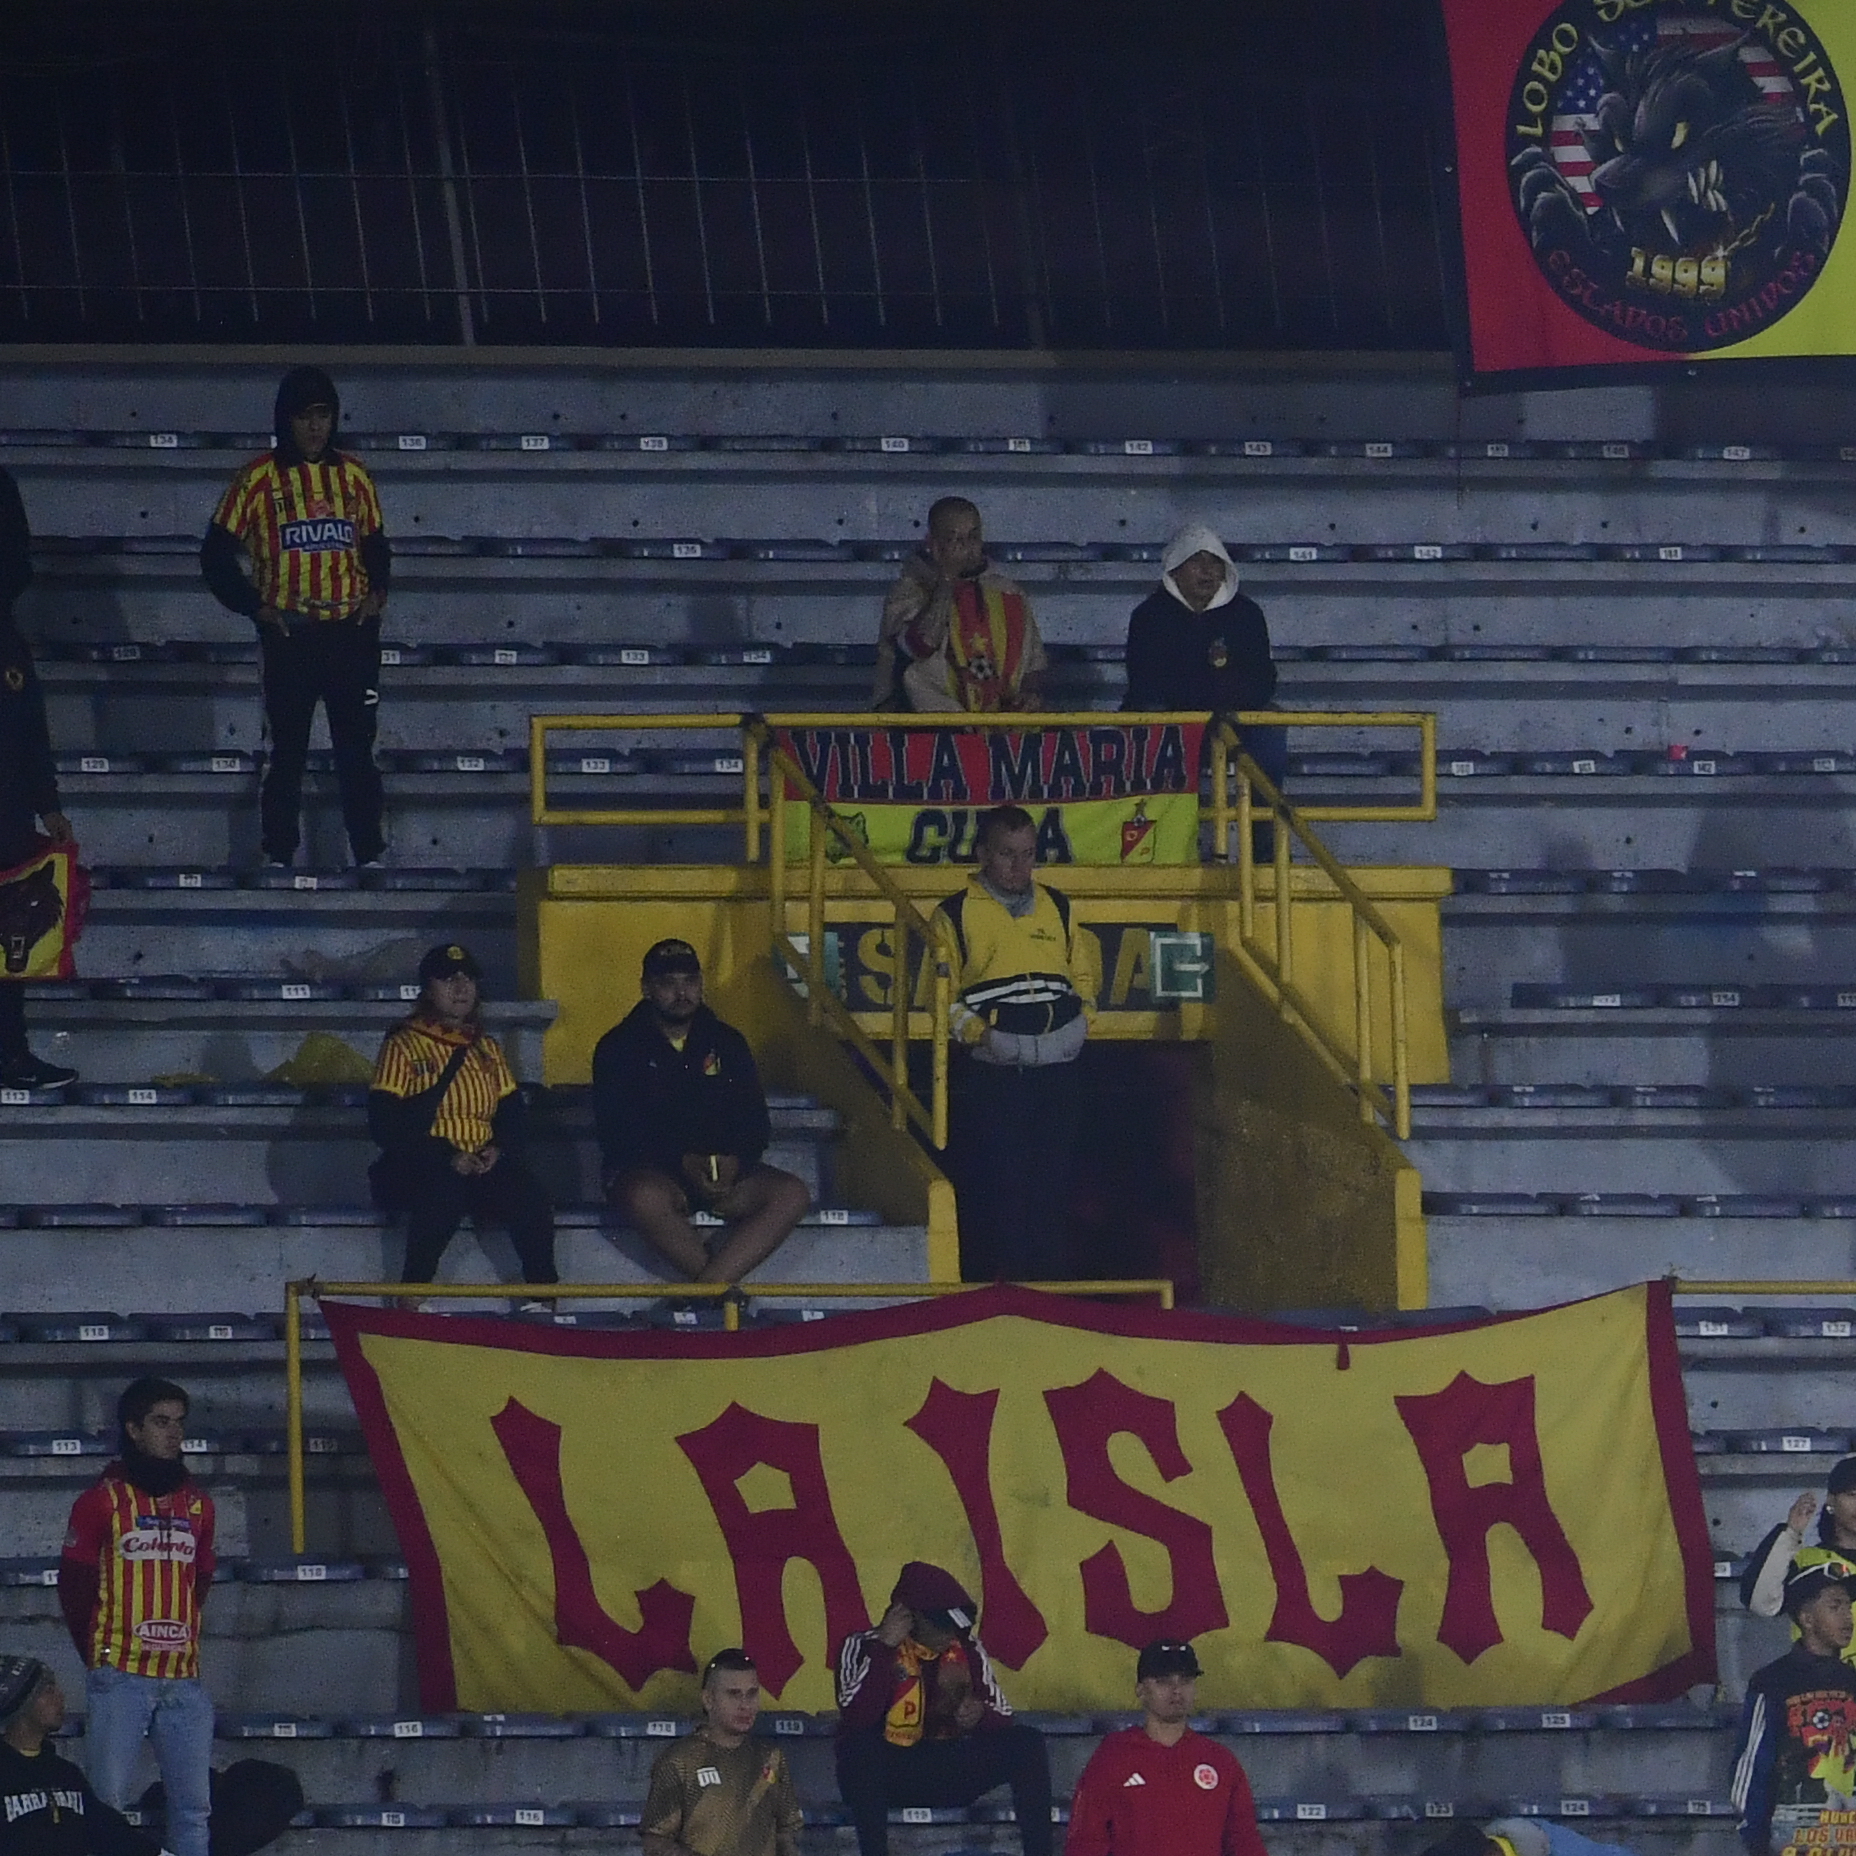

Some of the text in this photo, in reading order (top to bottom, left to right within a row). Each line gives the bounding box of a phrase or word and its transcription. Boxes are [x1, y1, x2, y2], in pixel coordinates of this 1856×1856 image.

[1516, 21, 1580, 137] LOBO
[84, 758, 106, 770] 129
[717, 761, 739, 770] 134
[788, 723, 1187, 800] VILLA MARIA
[908, 806, 1073, 864] CUA
[132, 1090, 153, 1101] 114
[56, 1441, 78, 1452] 113
